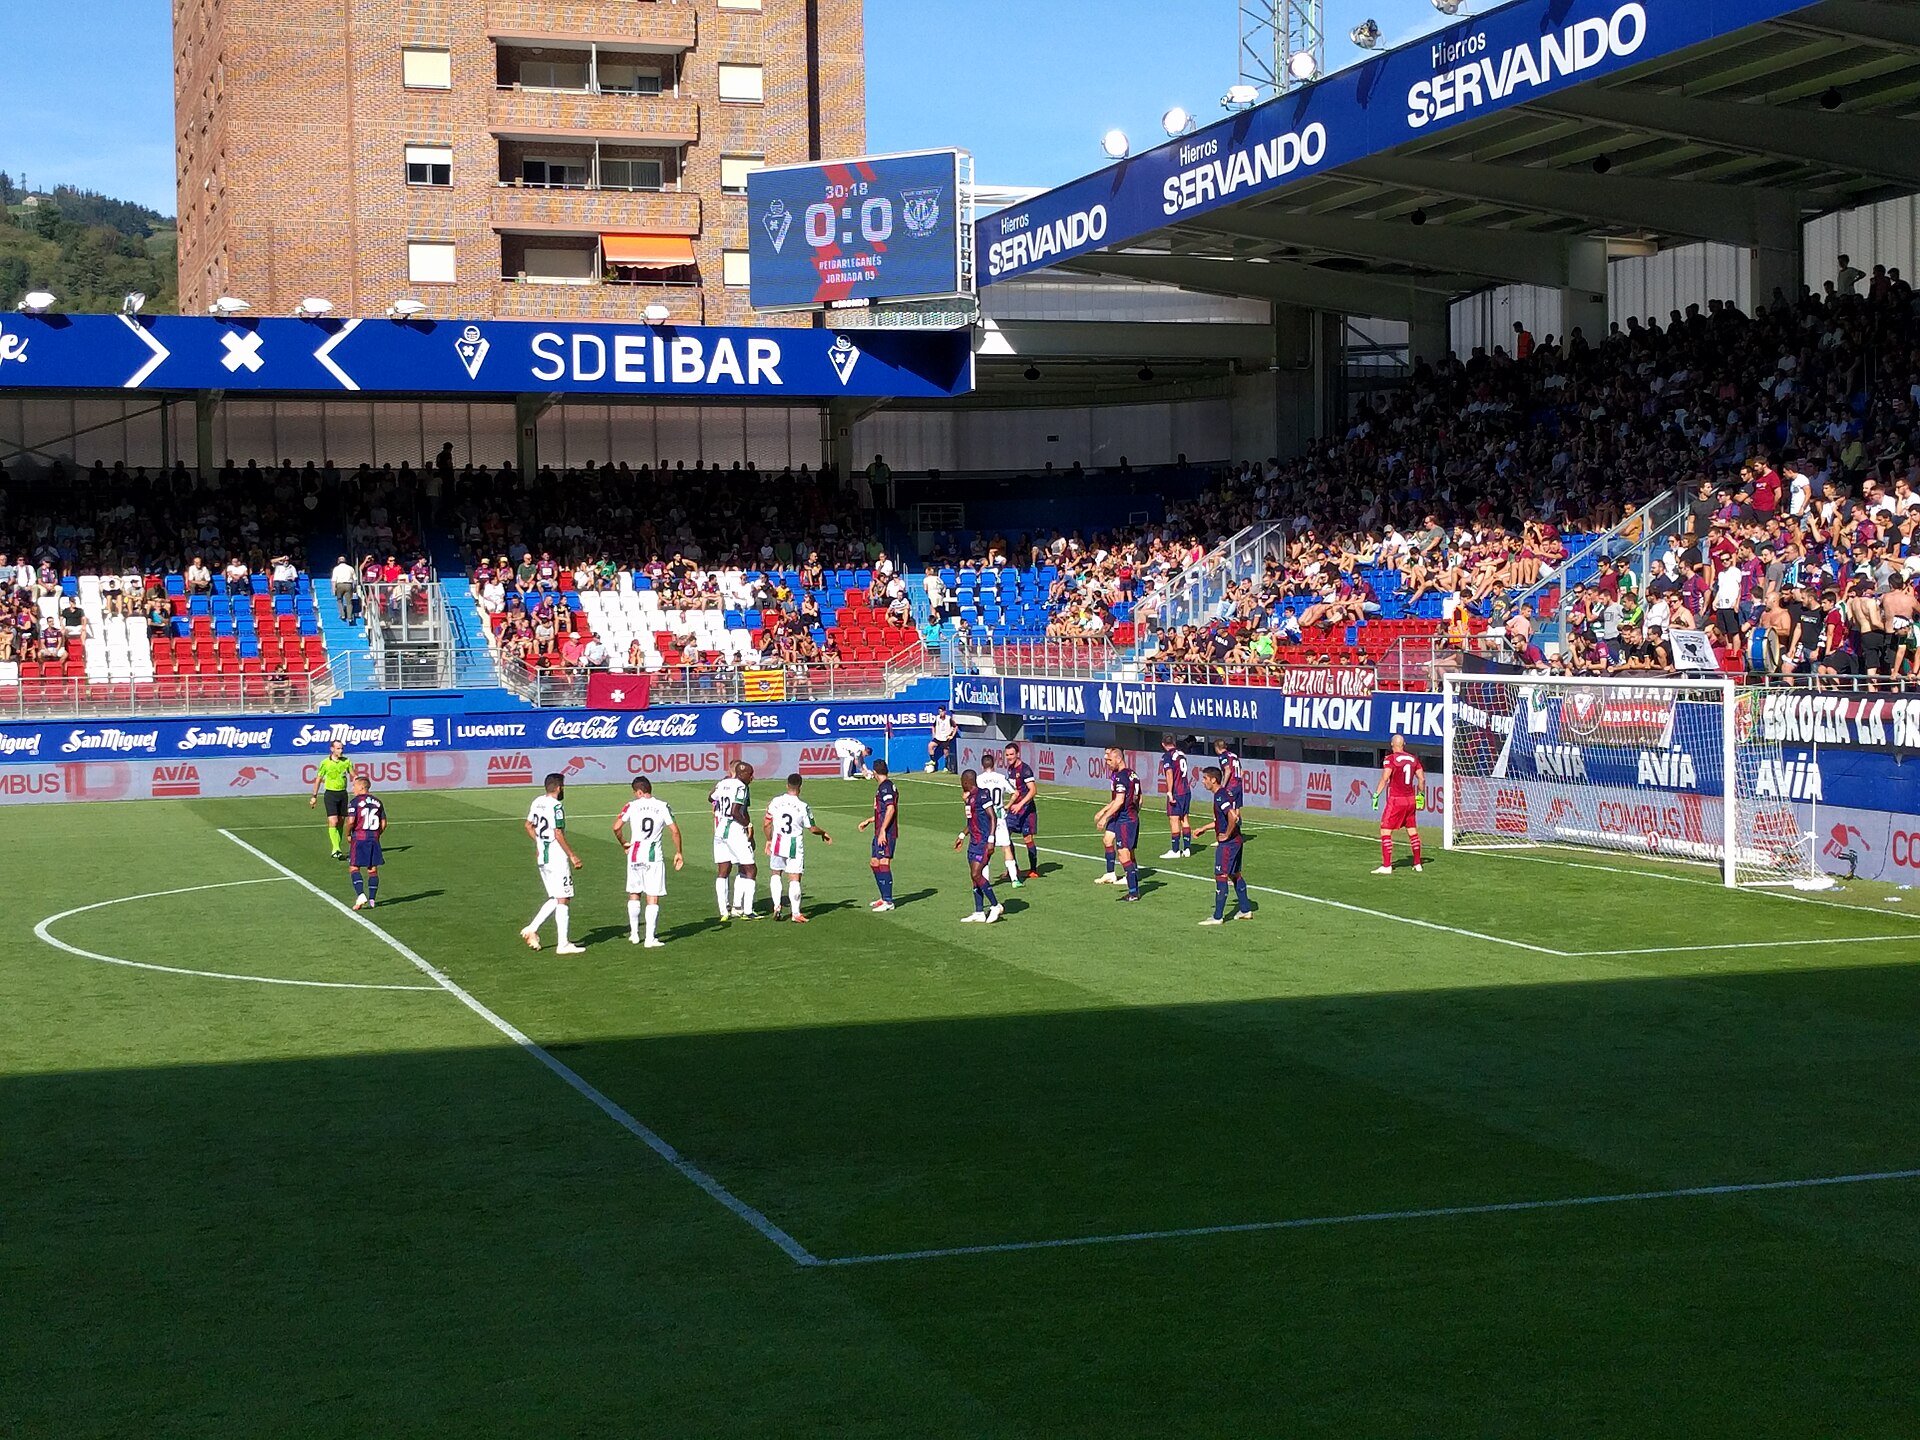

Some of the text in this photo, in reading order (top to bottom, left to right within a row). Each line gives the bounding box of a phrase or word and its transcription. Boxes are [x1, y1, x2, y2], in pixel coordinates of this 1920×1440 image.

[1430, 31, 1487, 69] Hierros
[1406, 2, 1648, 129] SERVANDO
[1179, 138, 1218, 167] Hierros
[1163, 122, 1327, 216] SERVANDO
[825, 182, 869, 199] 30:18
[1001, 211, 1030, 235] Hierros
[987, 203, 1108, 277] SERVANDO
[826, 271, 863, 283] JORNADA
[1020, 684, 1085, 715] PNEUMAX
[1115, 683, 1157, 723] Azpiri
[1189, 698, 1258, 720] AMENABAR
[744, 711, 778, 727] Taes
[838, 714, 917, 726] CARTONAJES
[1763, 694, 1850, 744] ESKOZIA
[1855, 698, 1886, 746] LA
[457, 724, 526, 738] LUGARITZ
[0, 733, 41, 755] iguel
[406, 739, 441, 747] SEAT
[302, 762, 402, 784] CBUS
[1179, 758, 1188, 778] 9
[1403, 764, 1411, 784] 1
[1243, 770, 1267, 796] BUS
[361, 808, 380, 830] 16
[641, 817, 654, 840] 9
[781, 813, 793, 834] 3
